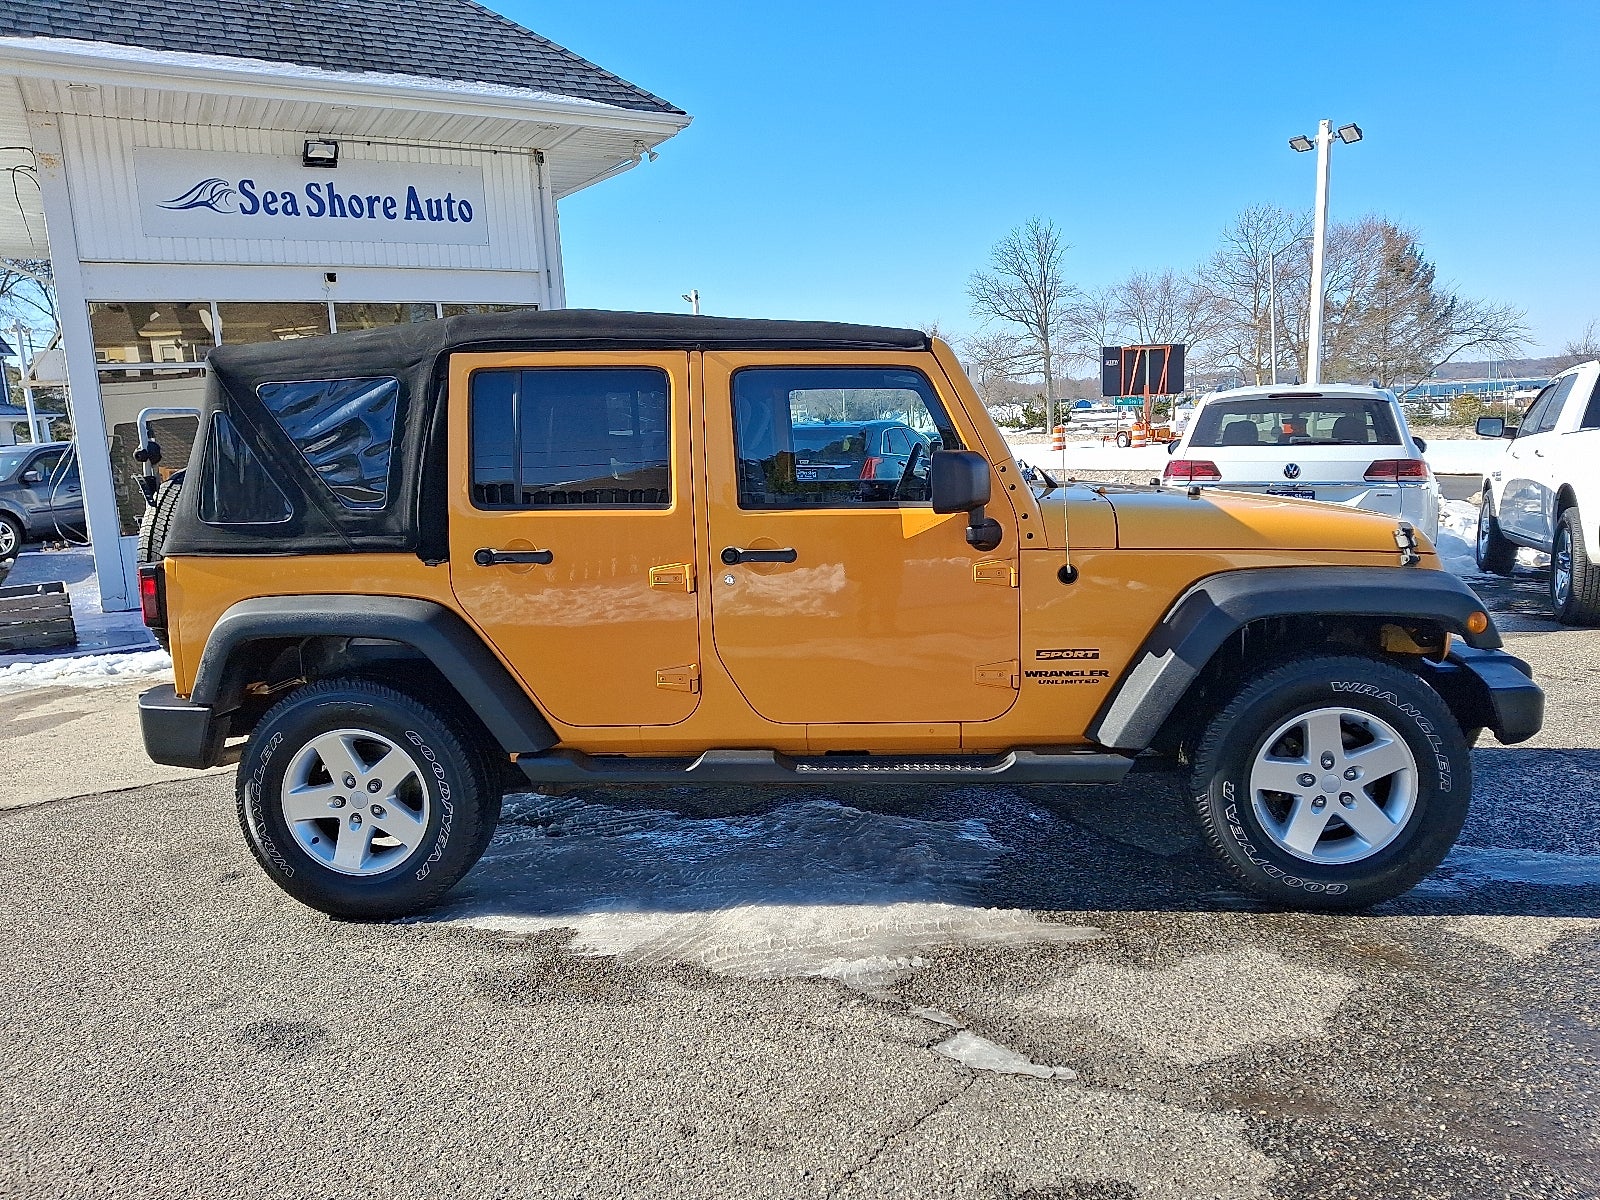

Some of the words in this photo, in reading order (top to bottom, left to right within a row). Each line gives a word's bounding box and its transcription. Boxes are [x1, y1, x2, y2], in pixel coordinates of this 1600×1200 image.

[237, 179, 300, 217] Sea
[305, 181, 397, 220] Shore
[403, 185, 474, 223] Auto
[1024, 670, 1109, 678] WRANGLER
[1036, 649, 1100, 660] SPORT
[1330, 681, 1454, 793] WRANGLER
[250, 731, 295, 878] WRANGLER
[405, 730, 453, 881] GOODYEAR
[1222, 780, 1348, 895] GOODYEAR
